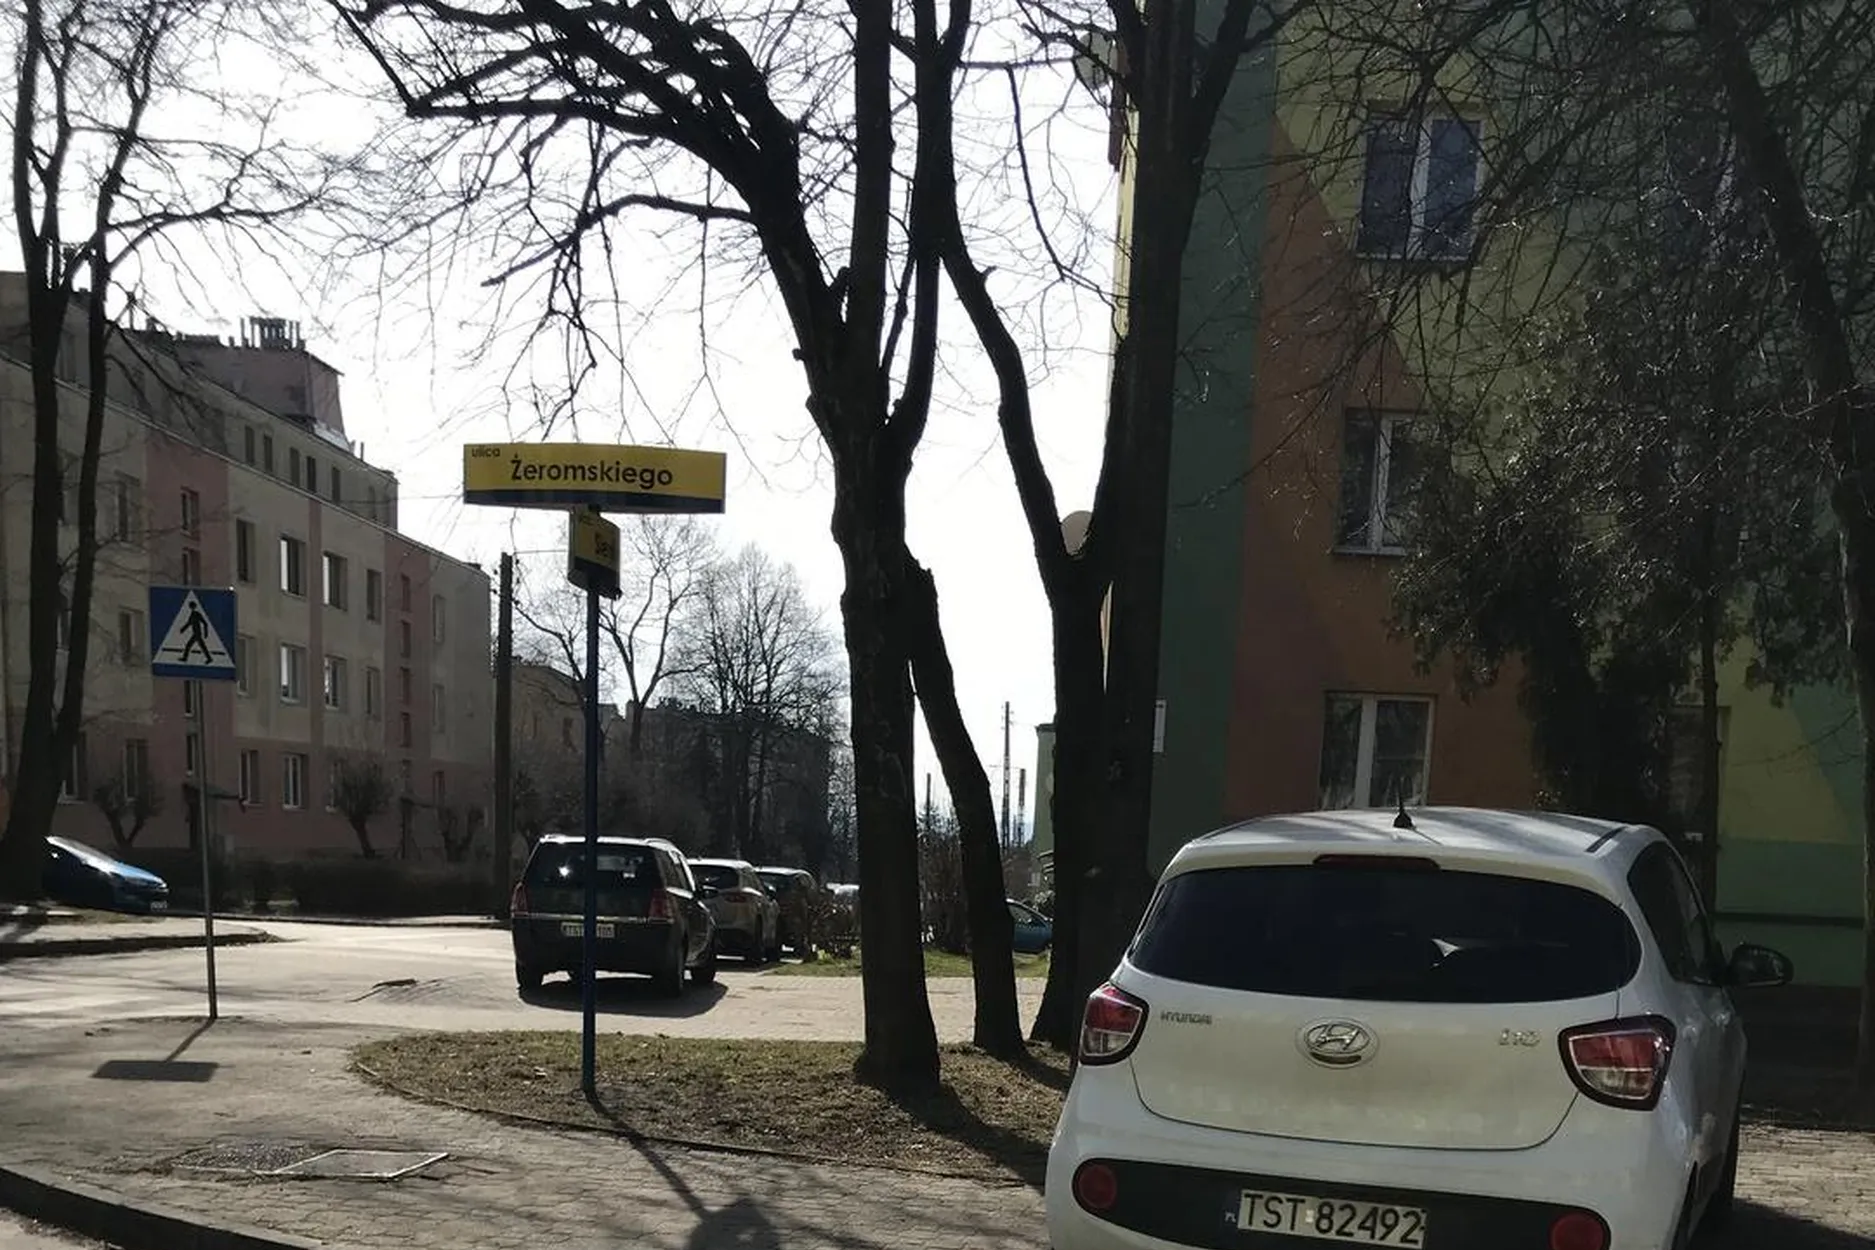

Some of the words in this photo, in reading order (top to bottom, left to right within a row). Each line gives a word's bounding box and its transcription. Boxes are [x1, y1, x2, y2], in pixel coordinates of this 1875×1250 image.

[471, 446, 500, 457] ulica
[510, 454, 673, 489] Żeromskiego
[1160, 1010, 1213, 1025] HYUNDAI
[1244, 1192, 1306, 1231] TST
[1314, 1201, 1422, 1245] 82492
